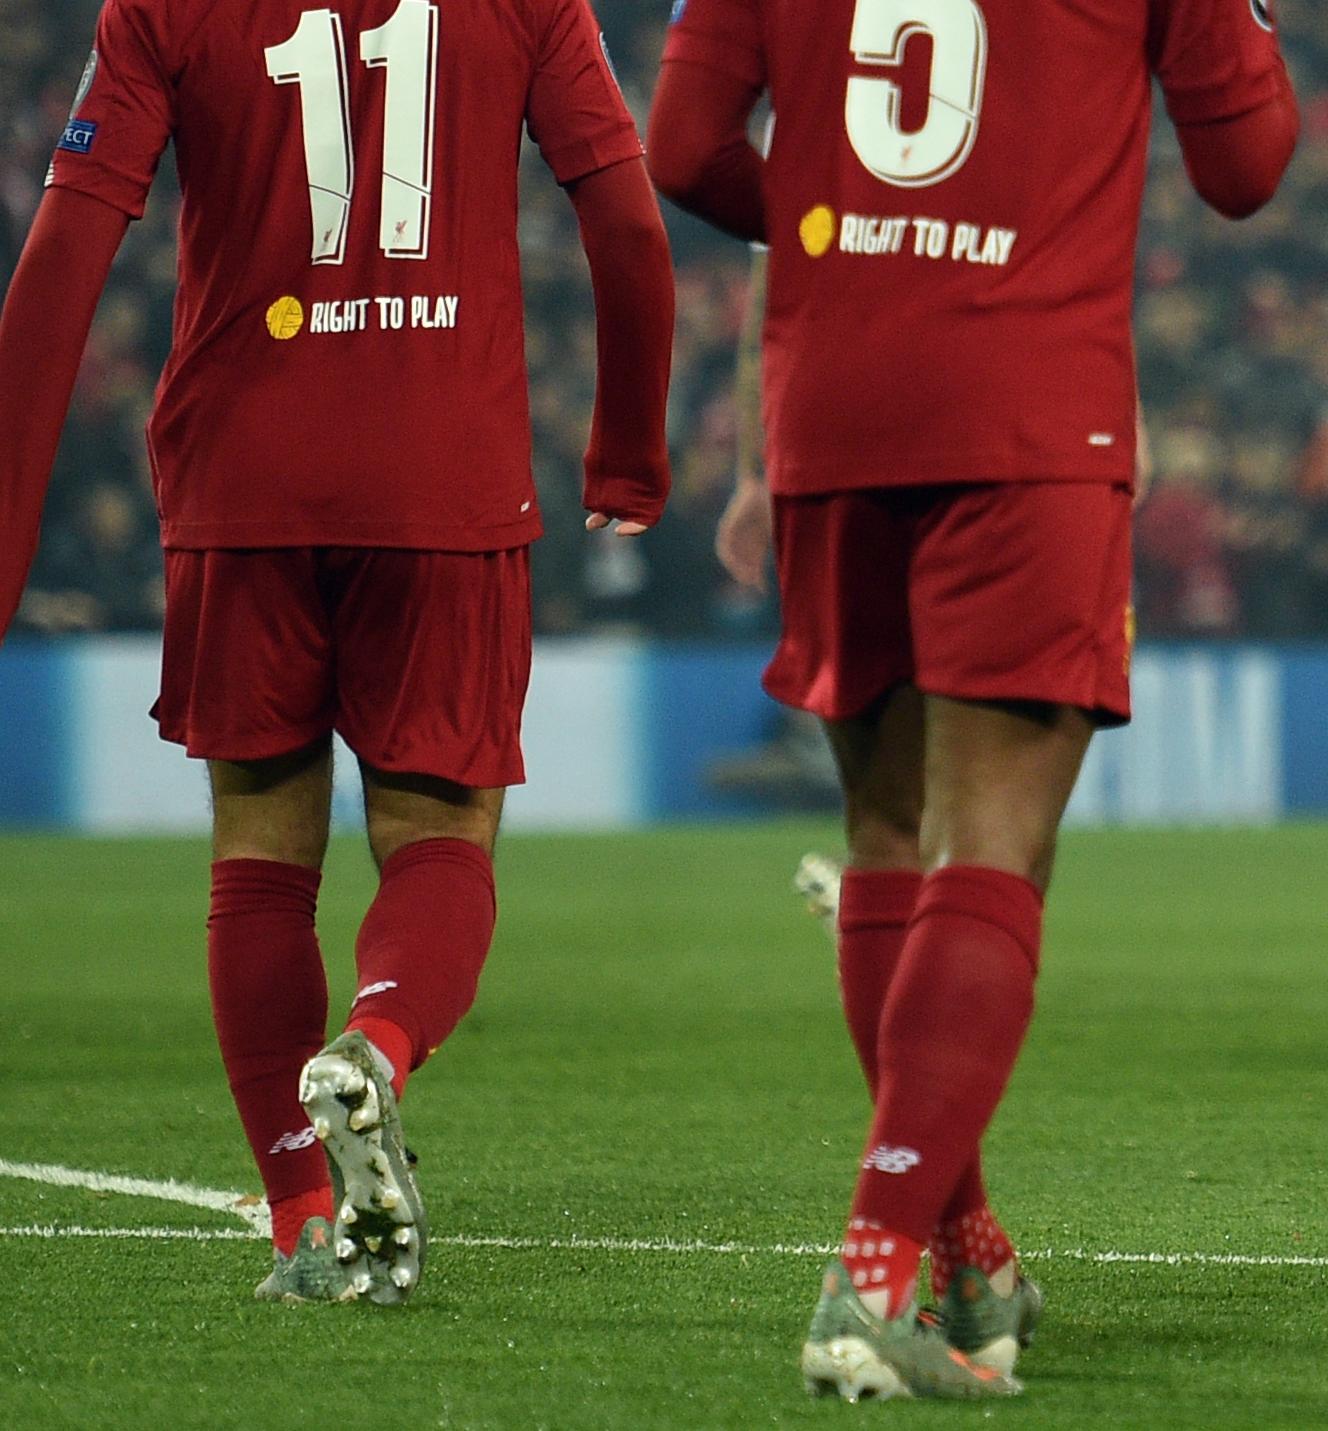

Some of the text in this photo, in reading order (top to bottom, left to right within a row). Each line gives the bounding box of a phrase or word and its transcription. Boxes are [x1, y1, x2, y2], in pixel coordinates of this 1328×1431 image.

[839, 213, 1017, 266] RIGHT TO PLAY
[309, 295, 459, 334] RIGHT TO PLAY
